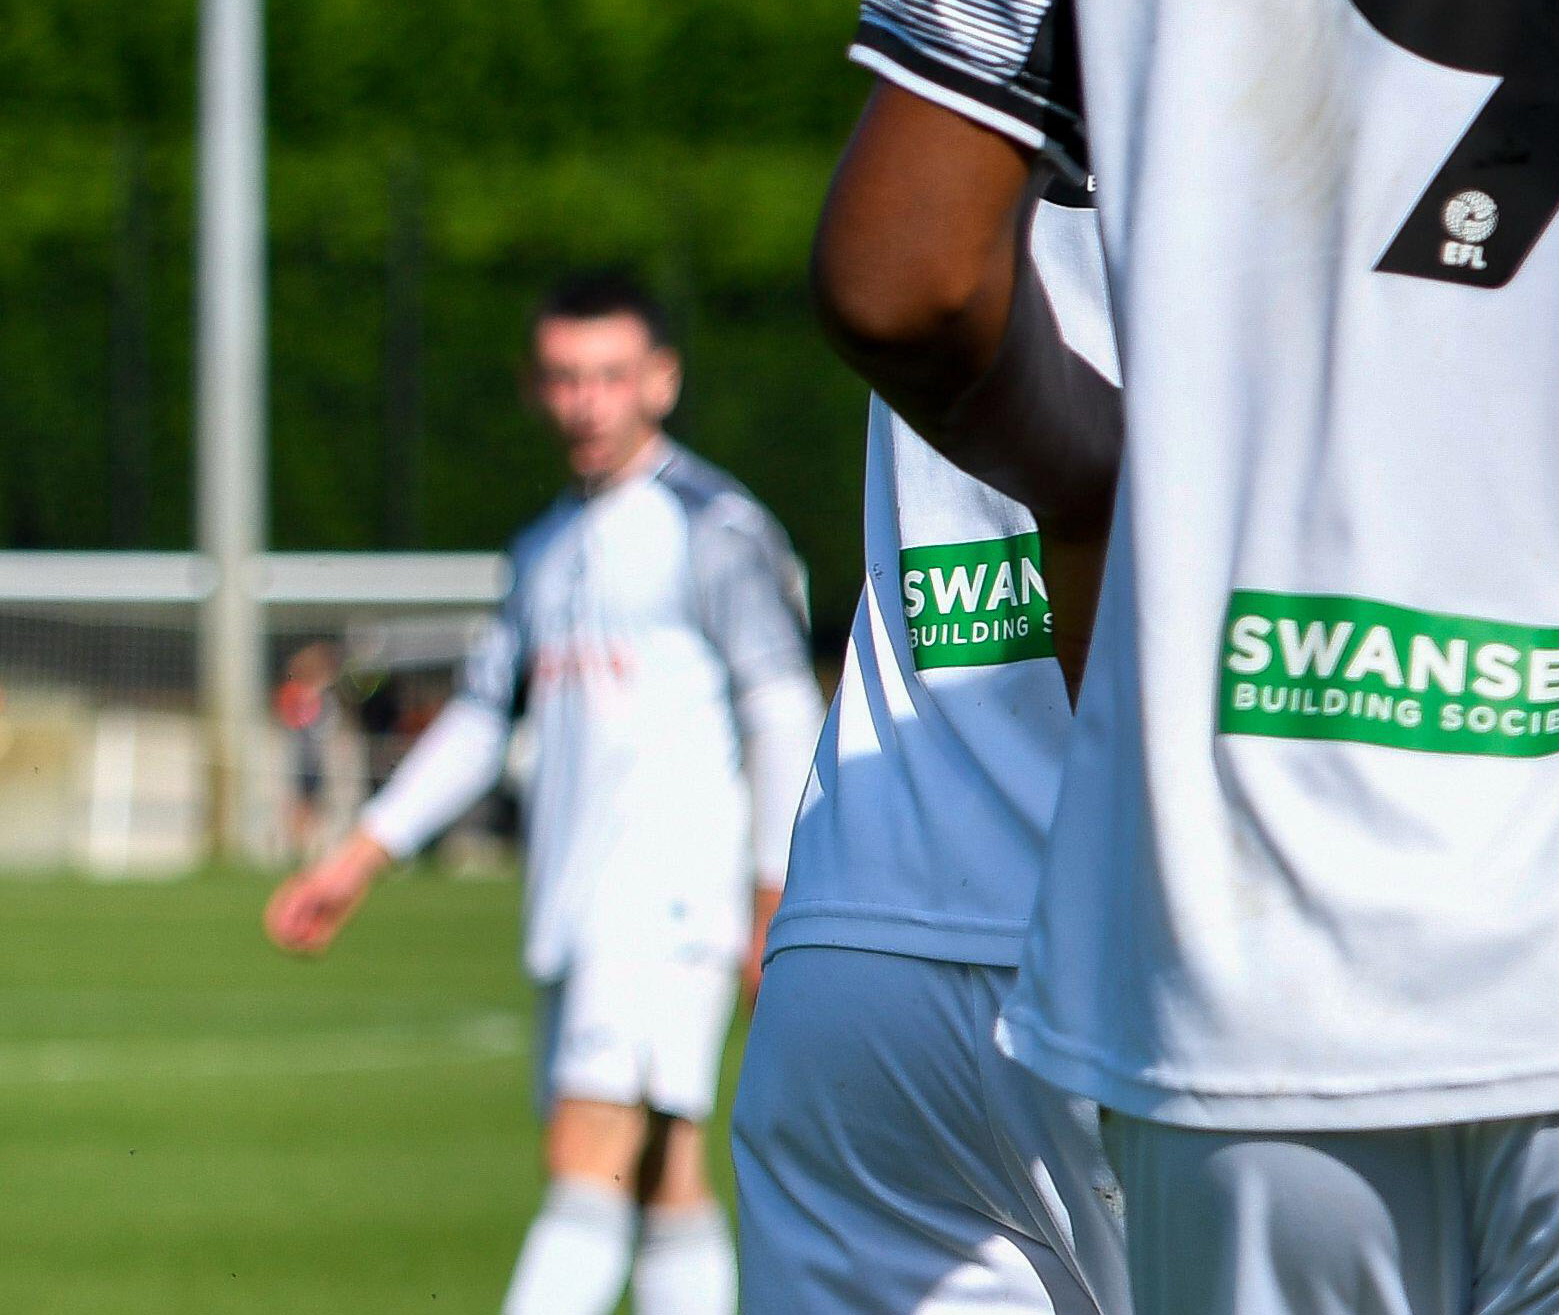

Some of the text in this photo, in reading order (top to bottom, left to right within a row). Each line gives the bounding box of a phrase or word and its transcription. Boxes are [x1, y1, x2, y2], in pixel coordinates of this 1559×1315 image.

[1443, 241, 1488, 270] EFL
[910, 616, 1029, 649] BUILDING
[1234, 683, 1423, 729] BUILDING
